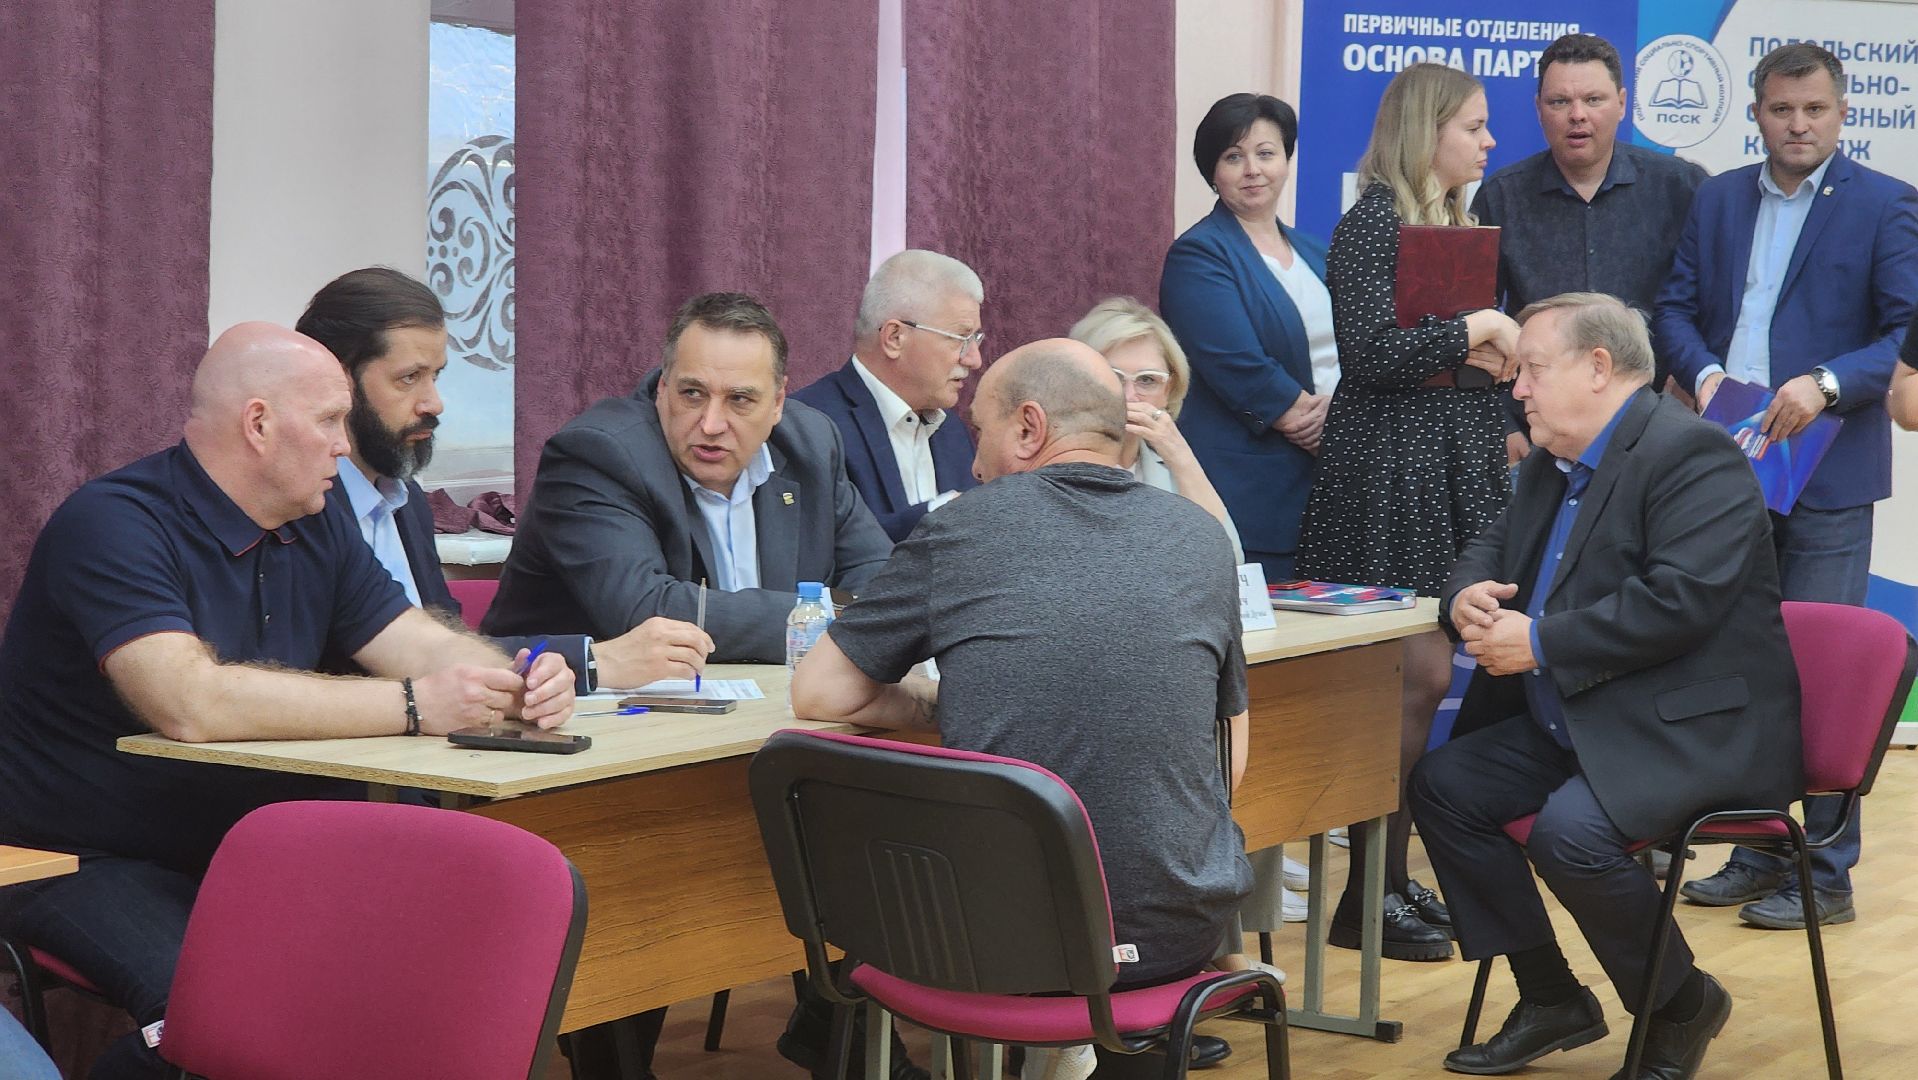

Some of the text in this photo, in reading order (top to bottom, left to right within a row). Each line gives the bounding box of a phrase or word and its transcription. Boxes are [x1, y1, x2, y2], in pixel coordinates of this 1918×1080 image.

[1343, 13, 1462, 37] ПЕРВИЧНЫЕ
[1464, 18, 1581, 43] ОТДЕЛЕНИЯ
[1343, 43, 1544, 79] ОСНОВА ПАРТ
[1656, 113, 1702, 125] ПССК
